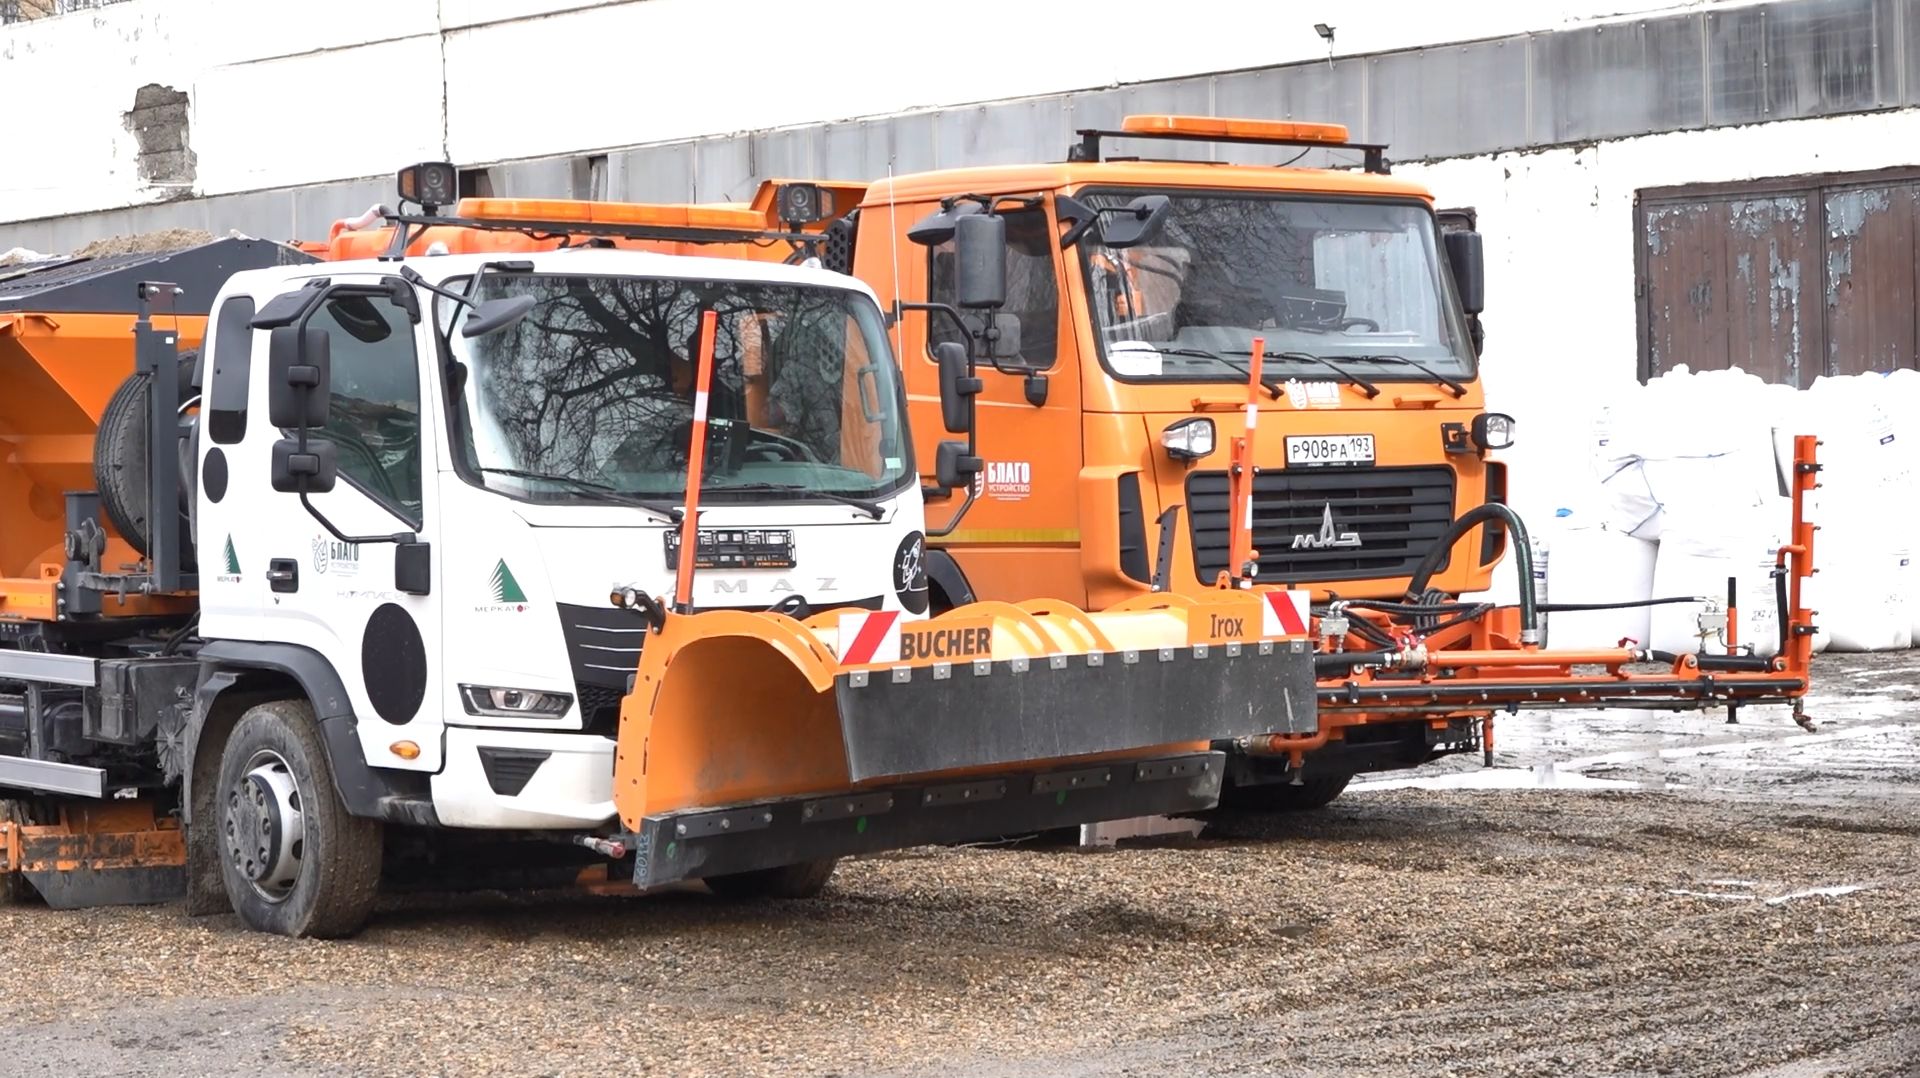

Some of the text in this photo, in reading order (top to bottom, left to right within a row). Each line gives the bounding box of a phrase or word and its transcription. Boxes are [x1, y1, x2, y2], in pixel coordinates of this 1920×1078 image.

[1350, 438, 1370, 452] 193
[987, 462, 1030, 483] БЛАГО
[330, 541, 359, 562] БЛАГО
[1210, 614, 1244, 638] Irox
[900, 627, 991, 661] BUCHER
